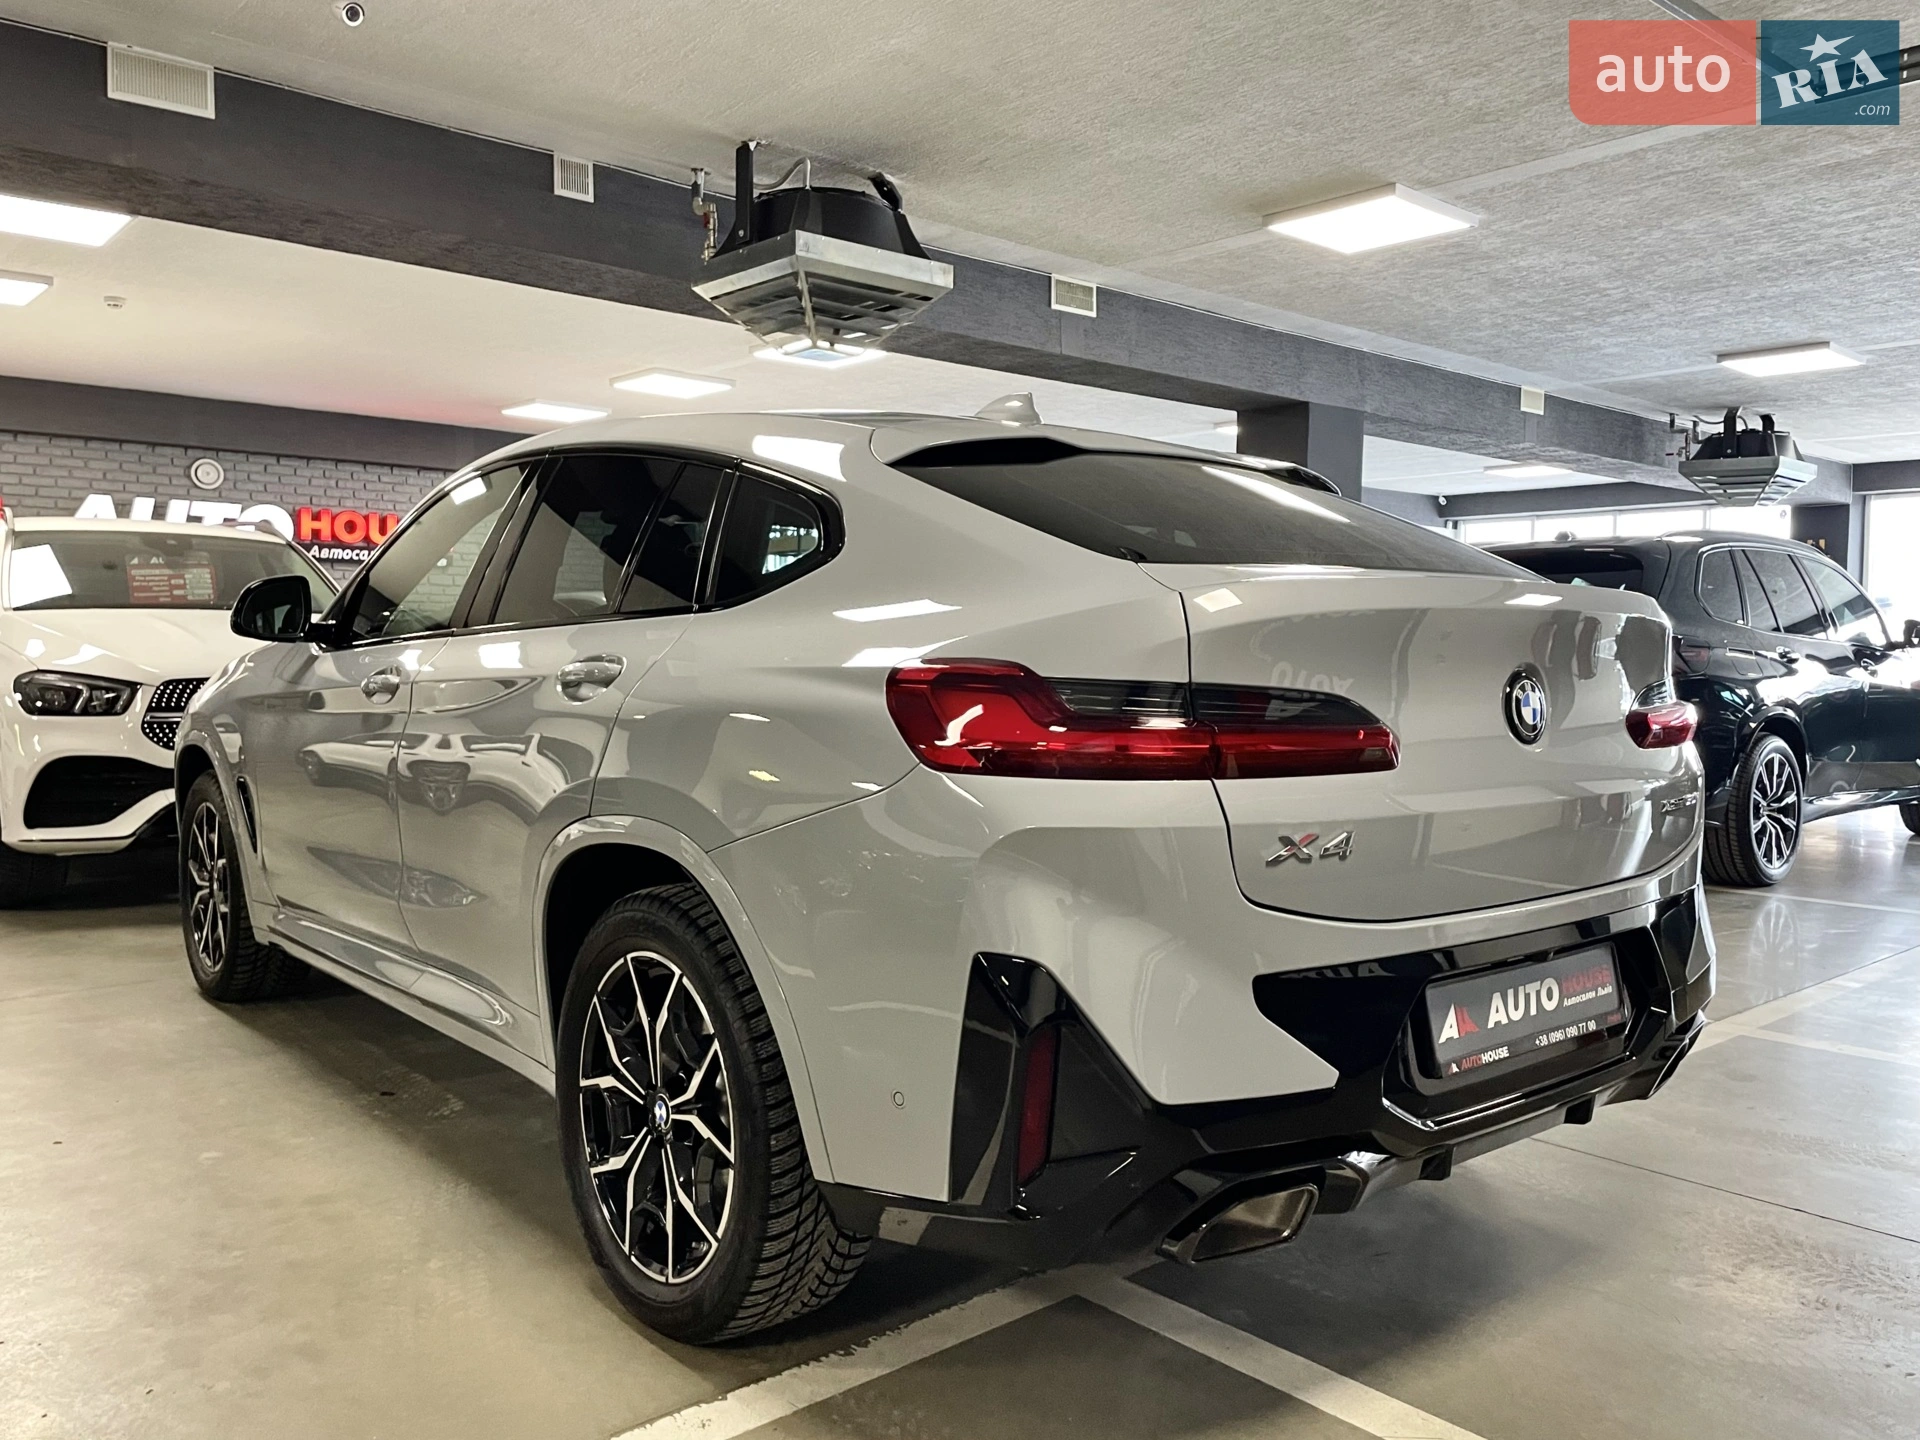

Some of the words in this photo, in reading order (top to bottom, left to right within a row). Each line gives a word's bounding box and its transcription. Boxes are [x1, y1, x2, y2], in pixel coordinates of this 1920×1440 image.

[296, 506, 399, 545] HOU
[1265, 831, 1356, 868] X4
[1487, 977, 1560, 1029] AUTO
[1562, 966, 1612, 993] HOUSE
[1535, 1033, 1549, 1047] +38
[1549, 1029, 1566, 1044] (096)
[1566, 1025, 1579, 1038] 090
[1578, 1022, 1587, 1034] 77
[1461, 1046, 1510, 1070] AUTOHOUSE
